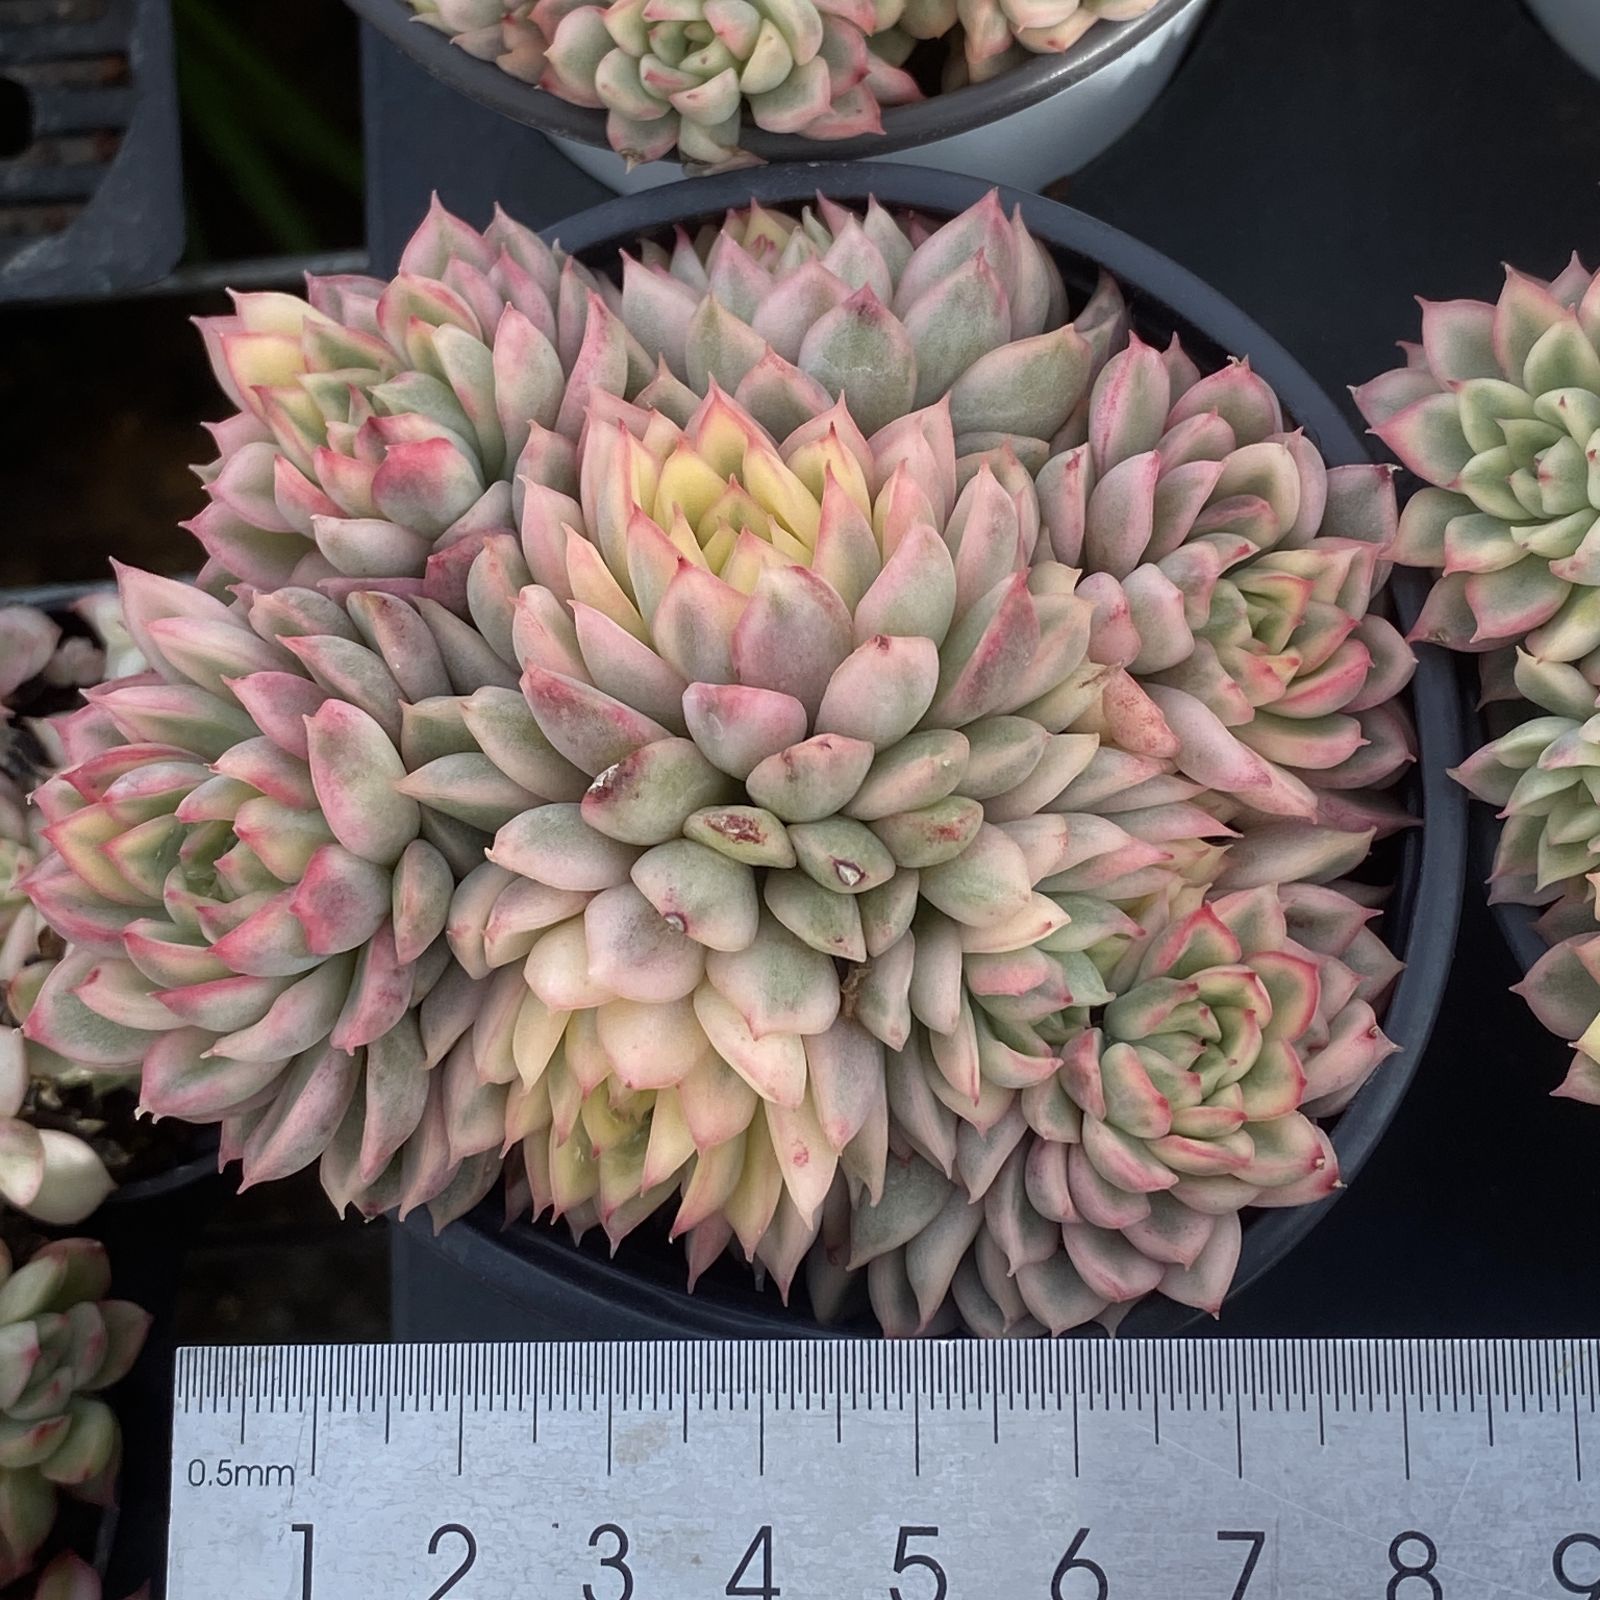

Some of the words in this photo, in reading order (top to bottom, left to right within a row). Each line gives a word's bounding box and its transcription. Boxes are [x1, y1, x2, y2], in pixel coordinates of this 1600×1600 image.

[187, 1458, 295, 1487] 0.5mm
[291, 1523, 314, 1600] 1
[427, 1523, 477, 1600] 2
[582, 1523, 634, 1600] 3
[725, 1525, 781, 1600] 4
[889, 1526, 948, 1600] 5
[1050, 1527, 1109, 1600] 6
[1216, 1530, 1266, 1600] 7
[1386, 1530, 1444, 1600] 8
[1552, 1532, 1600, 1600] 9
